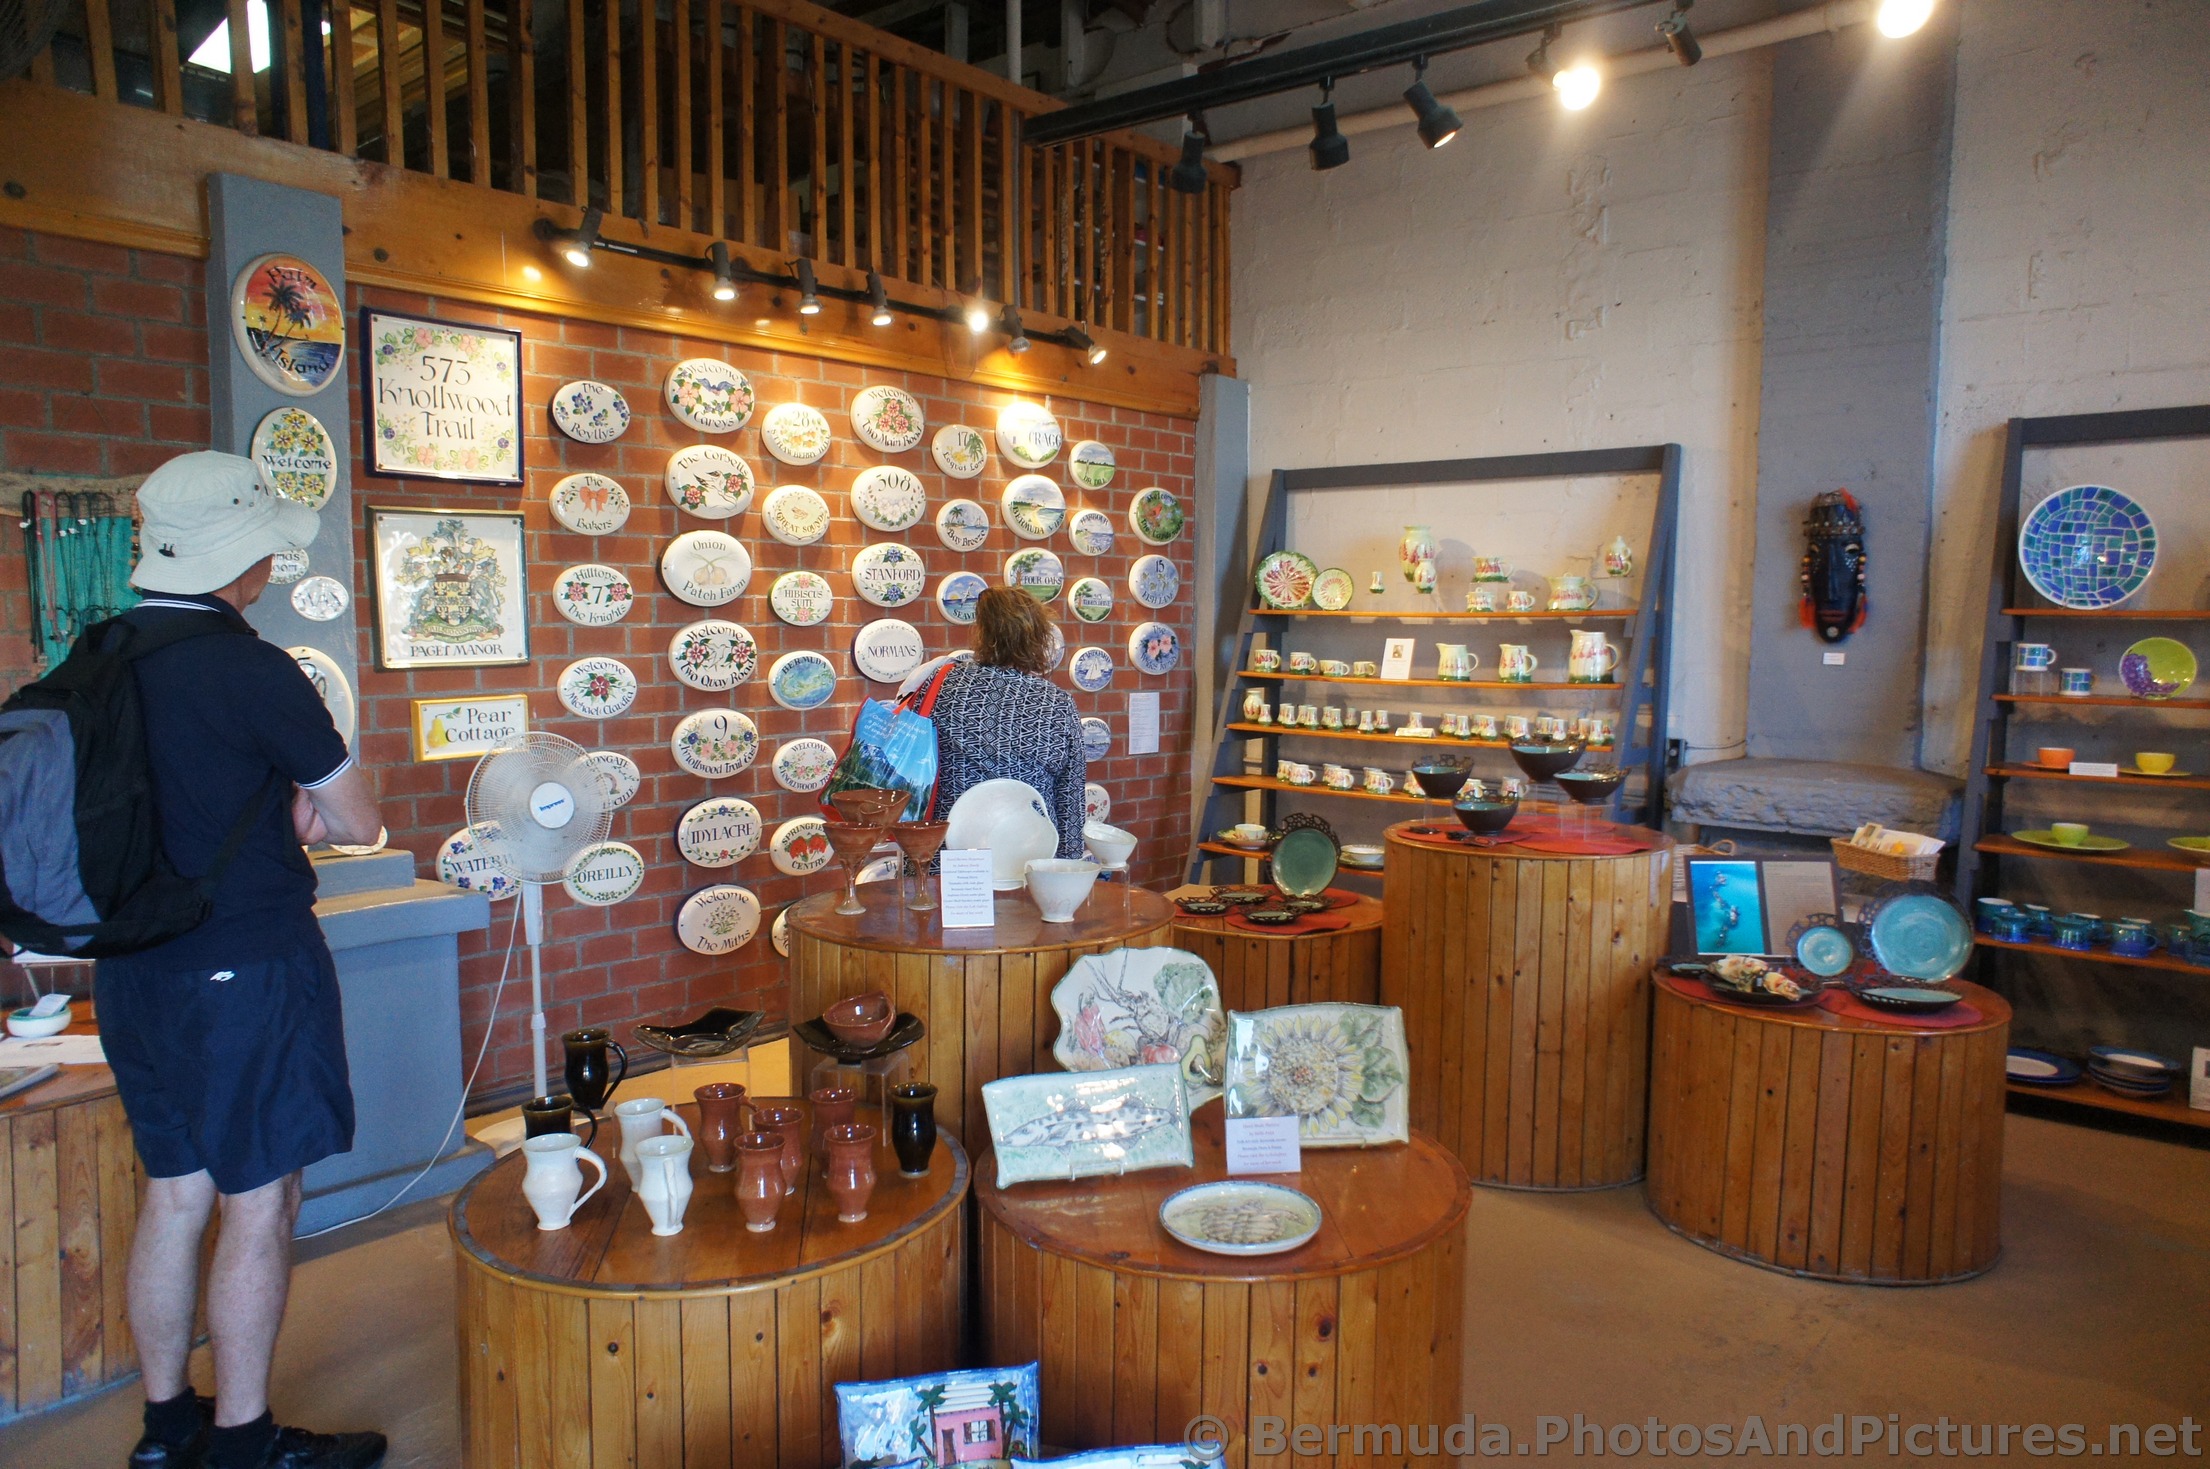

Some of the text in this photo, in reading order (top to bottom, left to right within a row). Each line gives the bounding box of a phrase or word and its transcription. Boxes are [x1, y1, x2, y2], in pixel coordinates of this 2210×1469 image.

[266, 266, 317, 289] Palm
[273, 347, 330, 374] Island
[420, 355, 471, 385] 573
[687, 363, 739, 381] Welcome
[378, 378, 512, 416] Knollwood
[582, 383, 603, 394] The
[868, 388, 914, 405] Welcome
[420, 411, 474, 440] Trail
[694, 411, 734, 430] Careys
[862, 419, 922, 447] Two Main Road
[958, 431, 968, 446] 17
[262, 455, 331, 469] Welcome
[678, 454, 700, 469] The
[943, 451, 966, 471] Loquat
[584, 476, 603, 487] The
[777, 512, 799, 533] GREAT
[1012, 506, 1045, 534] BERMUDA
[692, 540, 727, 552] Onion
[947, 528, 985, 547] Bay Breeze
[1086, 545, 1102, 554] VIEW
[273, 564, 297, 572] oom
[574, 567, 617, 582] Hilltops
[865, 568, 920, 581] STANFORD
[1155, 560, 1164, 573] 15
[1024, 576, 1062, 585] FOUR OAKS
[592, 586, 603, 604] 7
[682, 579, 746, 600] Patch Farm
[784, 589, 823, 598] HIBISCUS
[791, 599, 814, 607] SUITE
[568, 603, 626, 624] The Knights
[687, 625, 744, 641] Welcome
[411, 644, 503, 657] PAGET MANOR
[867, 645, 917, 658] NORMANS
[573, 661, 626, 675] Welcome
[680, 659, 754, 688] Two Quay Road
[782, 656, 827, 674] BERMUDA
[568, 691, 634, 716] Michael Claudia
[467, 708, 512, 724] Pear
[445, 727, 515, 745] Cottage
[714, 715, 727, 741] 9
[791, 742, 827, 753] WELCOME
[680, 743, 757, 774] Knollwood Trail East
[779, 767, 818, 790] KNOLLWOOD
[691, 823, 754, 844] IDYLACRE
[782, 822, 824, 845] SPRINGFIE
[791, 856, 826, 870] CENTRE
[884, 861, 898, 873] Th
[577, 865, 636, 883] O'REILLY
[695, 891, 749, 908] Welcome
[696, 935, 718, 952] The
